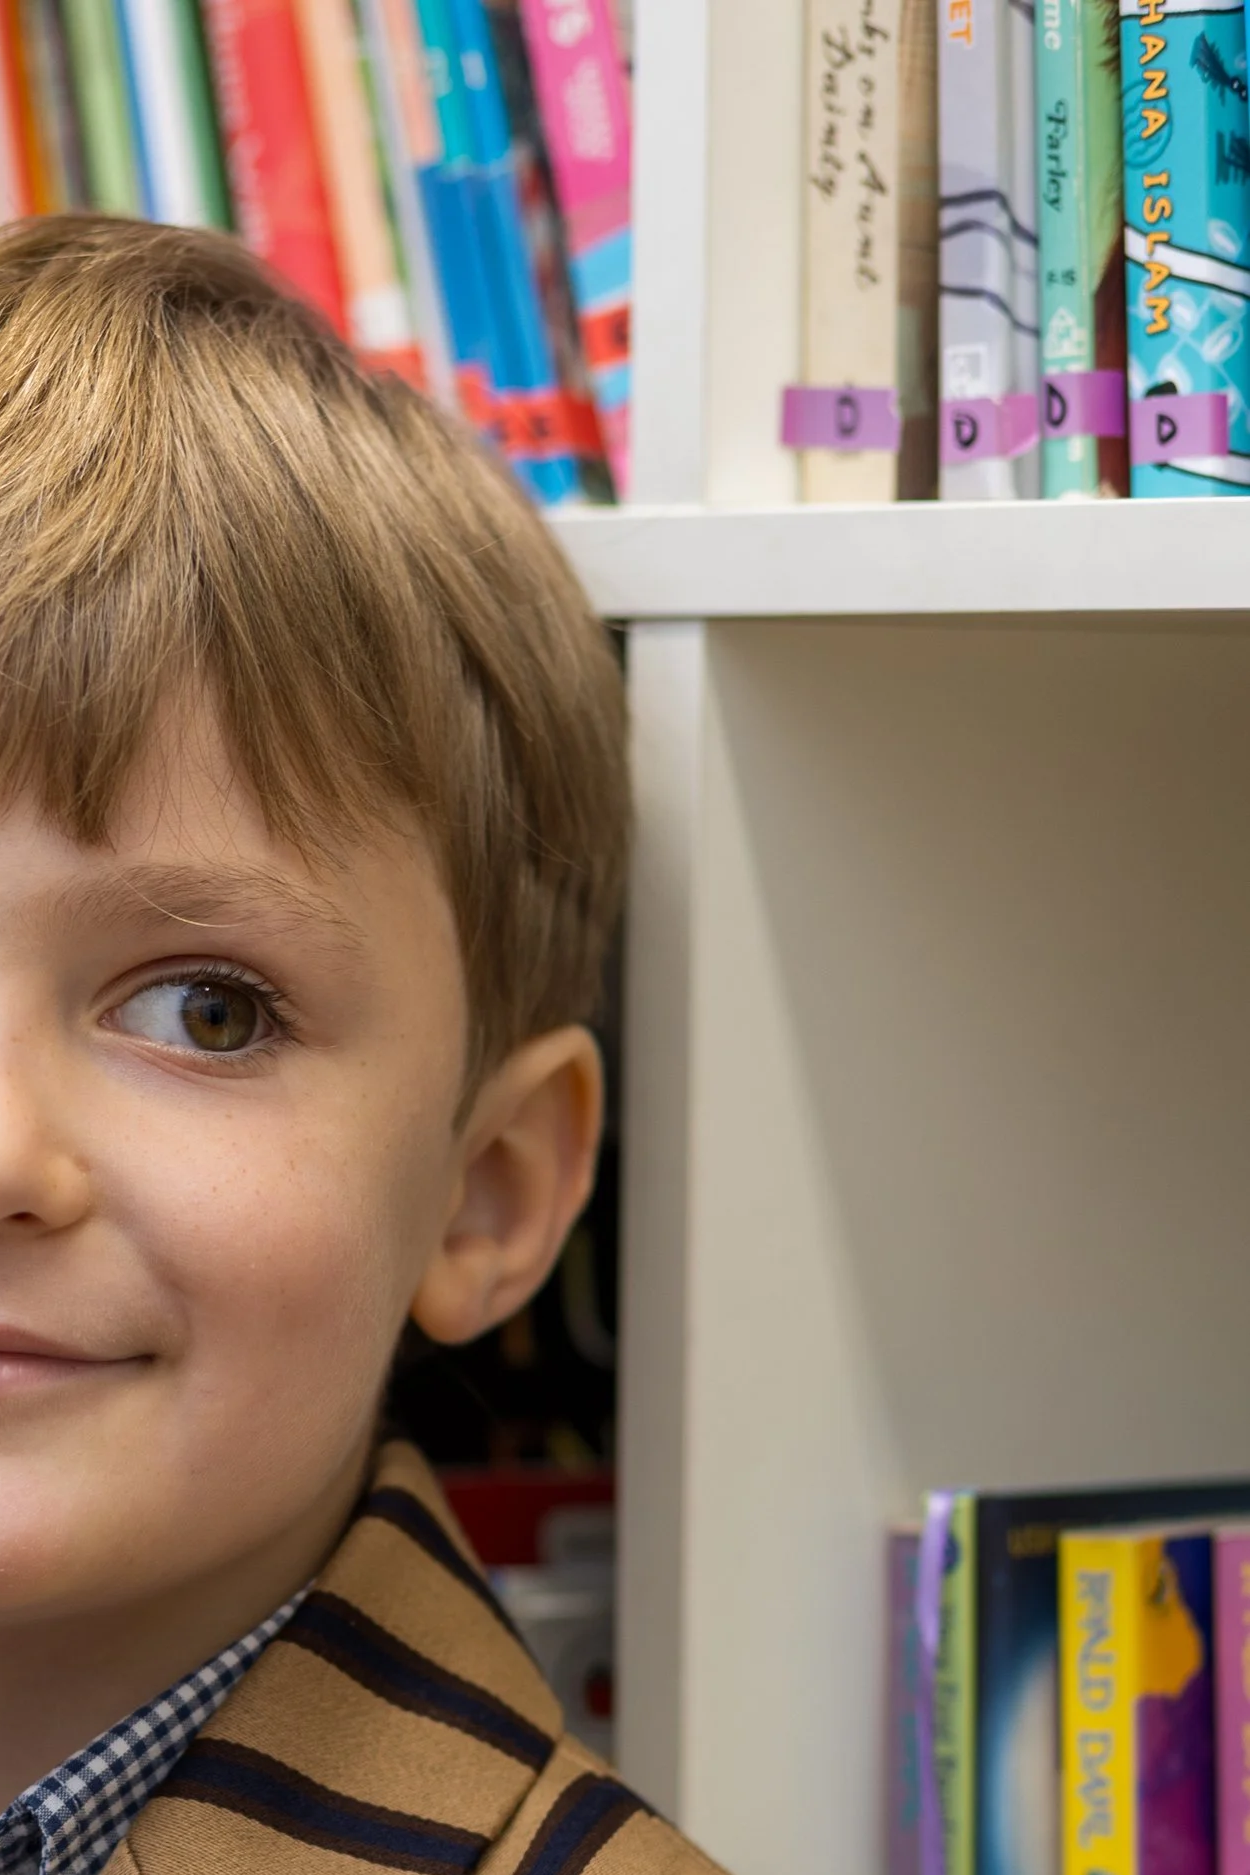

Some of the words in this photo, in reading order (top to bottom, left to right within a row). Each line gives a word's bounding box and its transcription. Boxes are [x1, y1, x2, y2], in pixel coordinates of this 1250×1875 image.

[949, 0, 973, 46] ET
[1138, 0, 1169, 139] HANA
[1043, 98, 1069, 213] Farley
[1142, 170, 1172, 335] ISLAM
[1046, 383, 1068, 429] D
[953, 411, 979, 449] D
[1157, 413, 1178, 447] D
